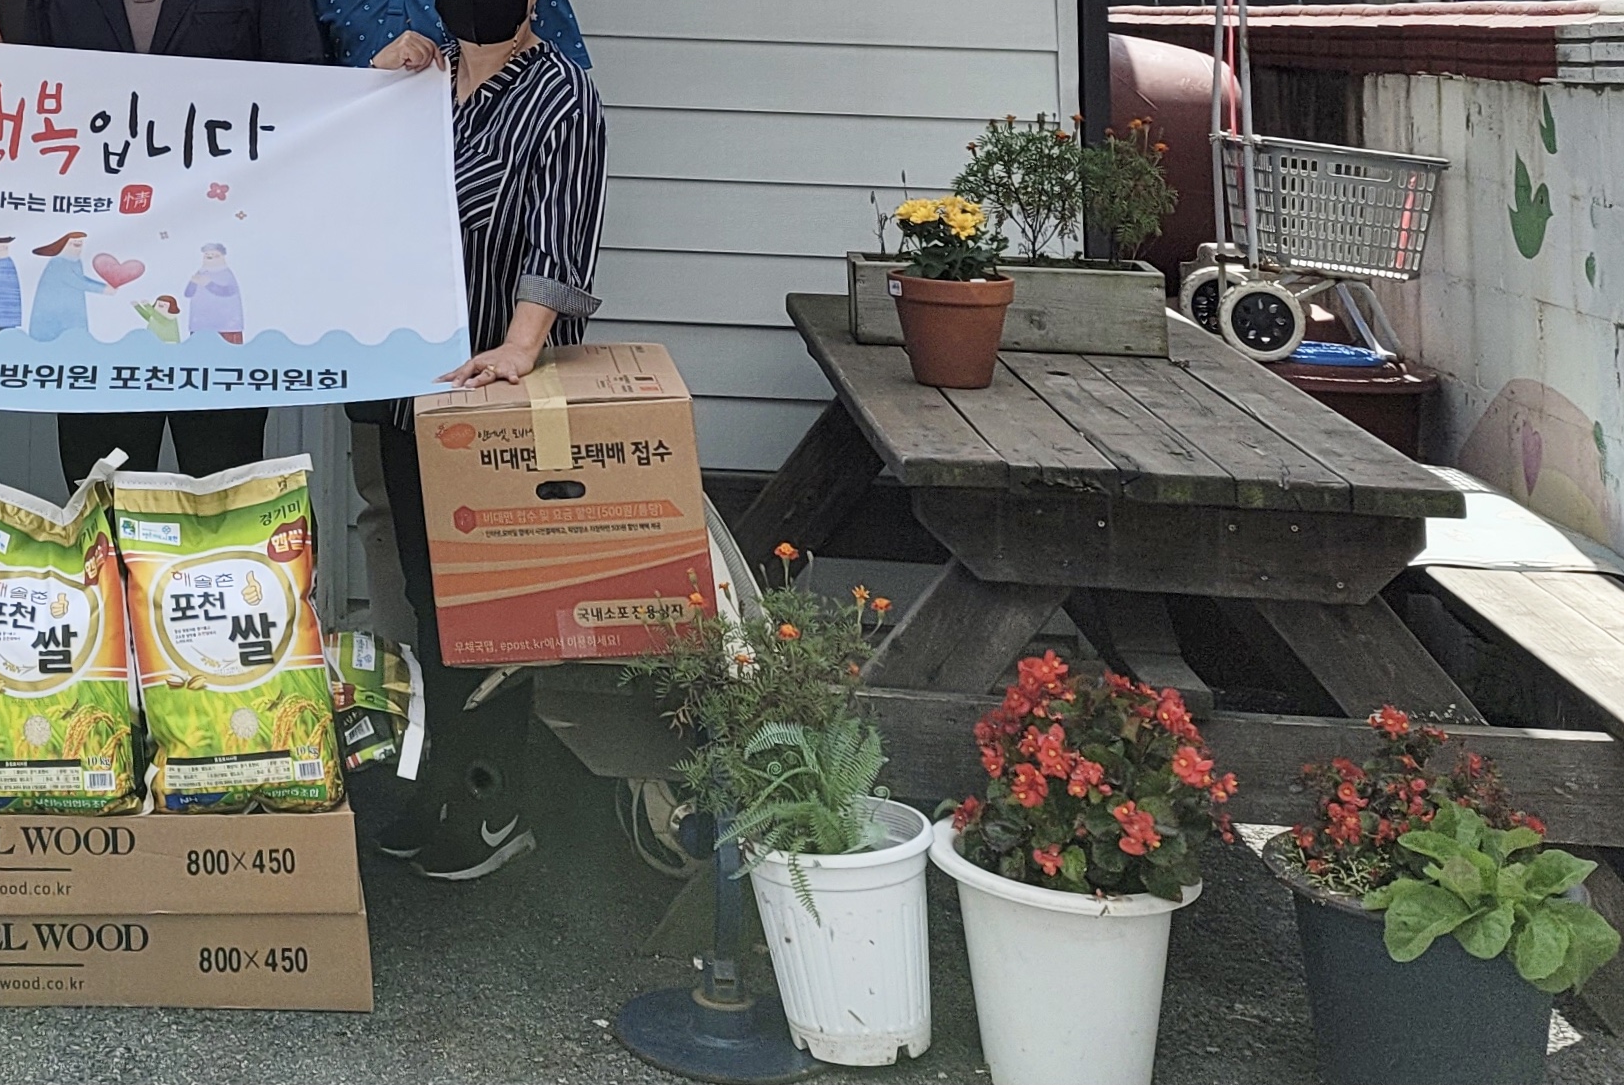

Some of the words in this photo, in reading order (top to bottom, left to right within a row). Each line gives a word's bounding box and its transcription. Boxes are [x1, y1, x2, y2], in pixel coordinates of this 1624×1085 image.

[52, 195, 114, 214] 따뜻한
[109, 365, 348, 392] 포천지구위원회
[554, 441, 626, 471] 문택배
[630, 439, 672, 466] 접수
[259, 500, 301, 526] 경기미
[170, 591, 227, 621] 포천
[31, 624, 78, 674] 쌀
[228, 612, 276, 667] 쌀
[26, 826, 136, 856] WOOD
[36, 923, 149, 953] WOOD
